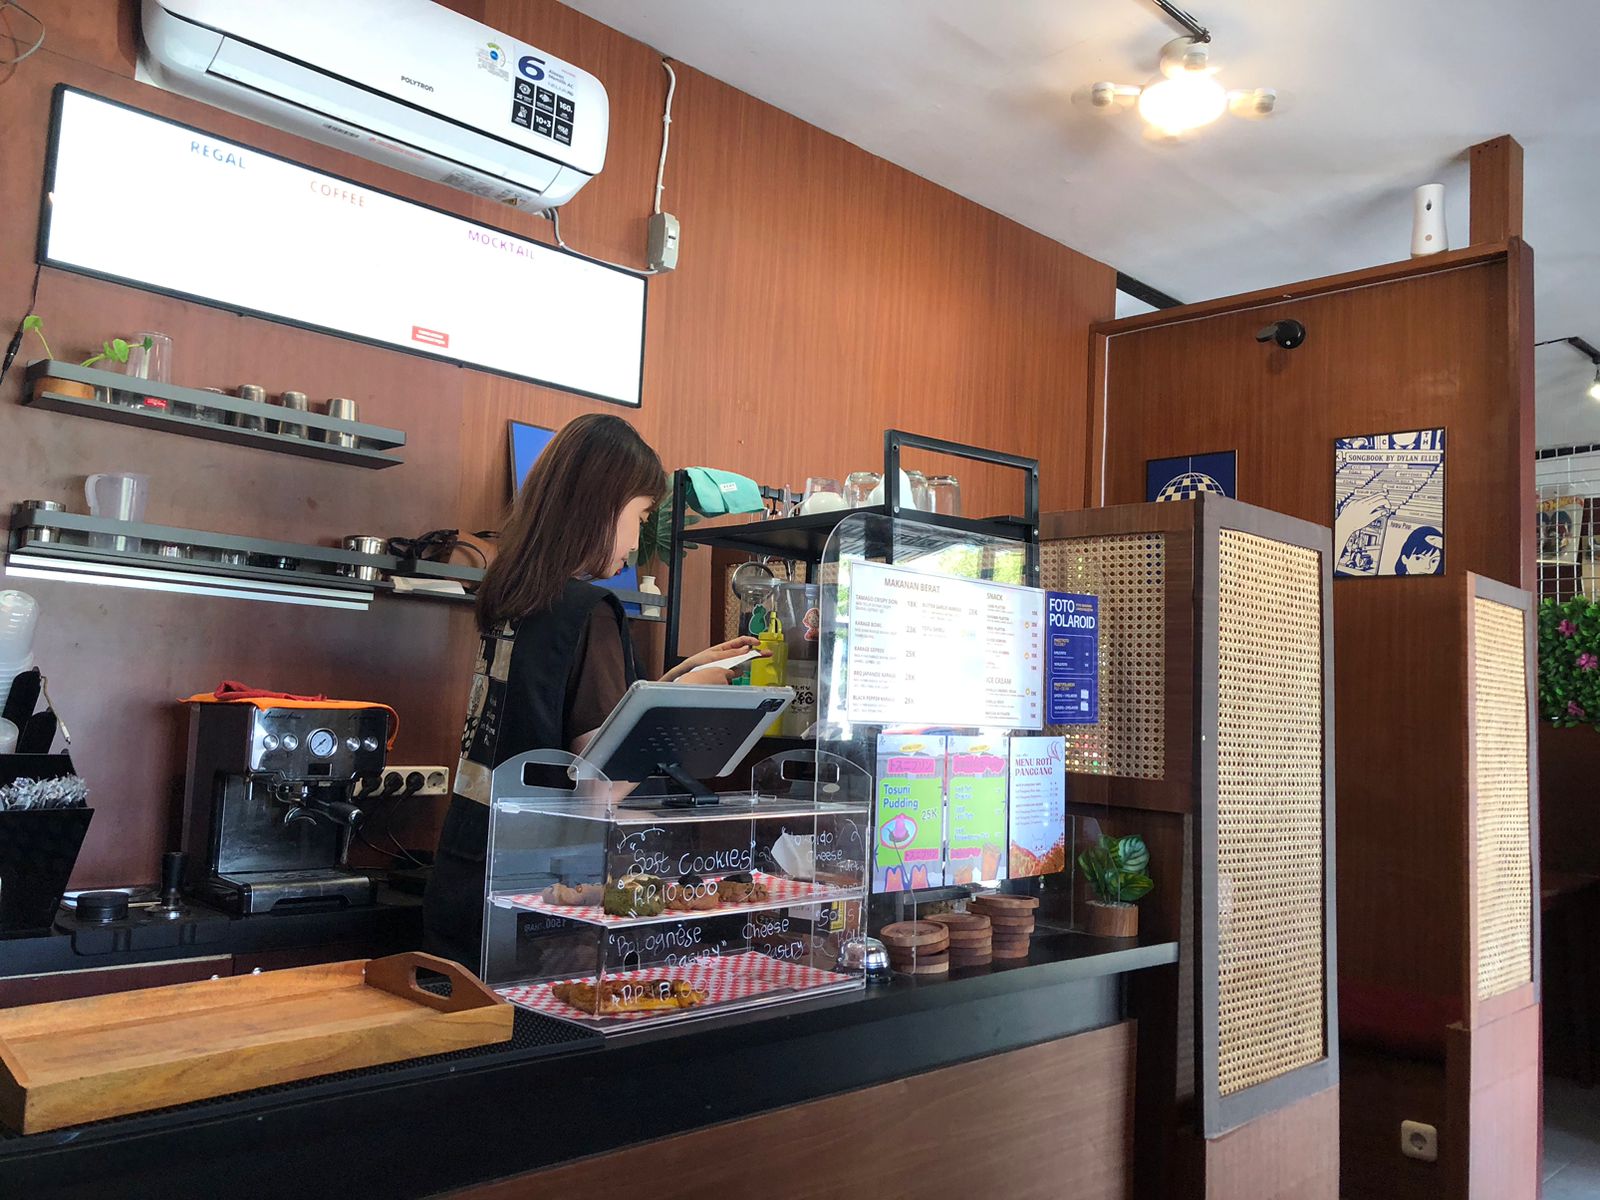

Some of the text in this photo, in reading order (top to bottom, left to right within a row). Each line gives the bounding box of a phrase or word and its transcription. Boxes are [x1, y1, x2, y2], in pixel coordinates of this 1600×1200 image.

[518, 56, 546, 81] 6
[401, 75, 435, 93] POLYTRON
[190, 140, 246, 169] REGAL
[310, 180, 366, 208] COFFEE
[468, 229, 535, 260] MOCKTAIL
[1396, 454, 1419, 462] DYLAN
[884, 578, 940, 593] MAKANAN BERAT
[987, 592, 1003, 601] SNACK
[1049, 598, 1075, 613] FOTO
[1049, 613, 1096, 629] POLAROID
[995, 677, 1012, 685] CREAM
[1015, 757, 1052, 767] MENU ROTI
[1015, 767, 1053, 777] PANGGANG
[883, 784, 911, 795] Tosuni
[883, 798, 919, 810] Pudding
[921, 809, 938, 821] 25K
[742, 918, 790, 940] Cheese
